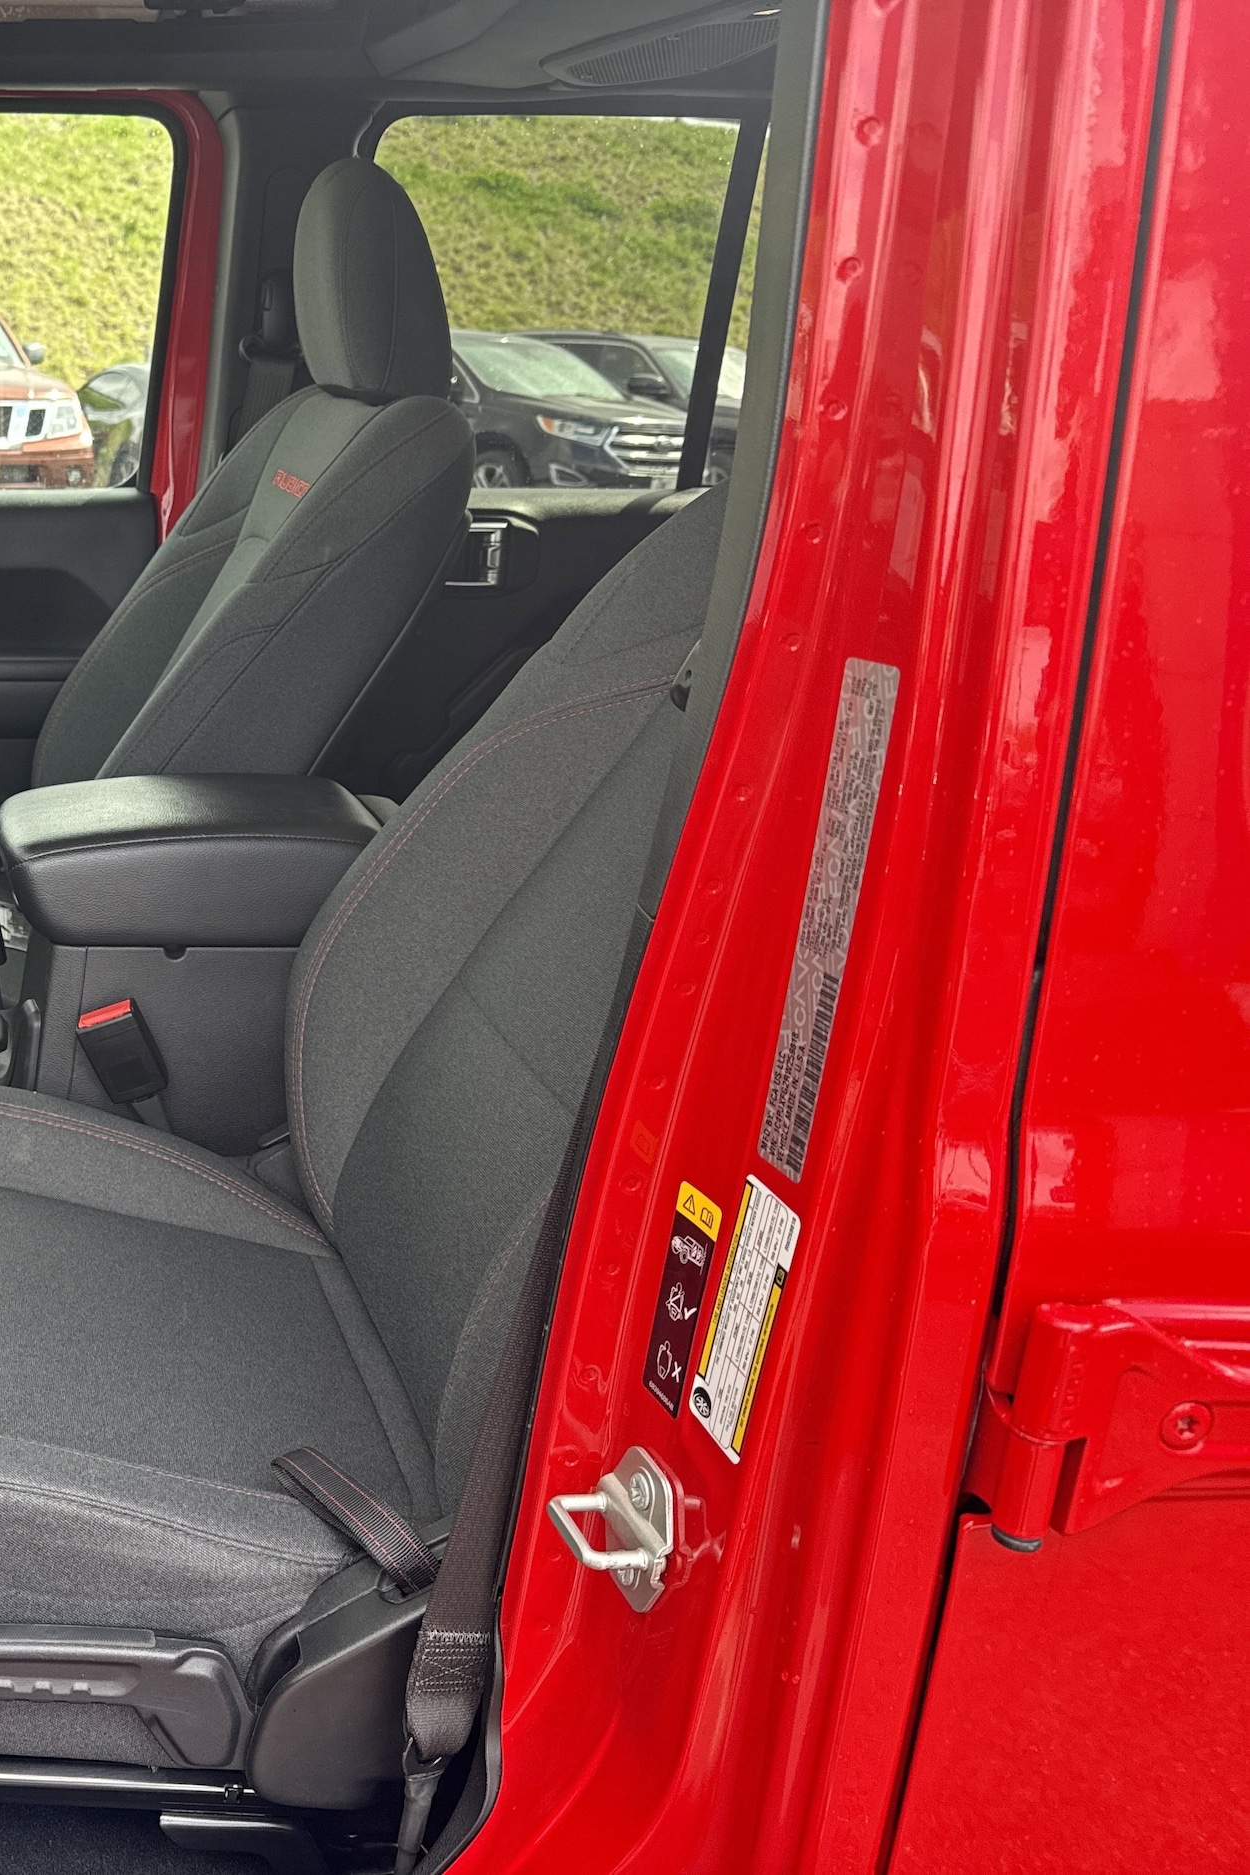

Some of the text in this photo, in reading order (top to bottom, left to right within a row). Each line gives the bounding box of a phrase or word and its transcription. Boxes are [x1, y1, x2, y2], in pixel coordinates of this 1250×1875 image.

[776, 1050, 785, 1069] LLC
[773, 1070, 781, 1085] US
[769, 1086, 778, 1107] FCA
[776, 1120, 789, 1162] VEHICLE
[785, 1090, 795, 1120] MADE
[768, 1135, 777, 1156] VIN:
